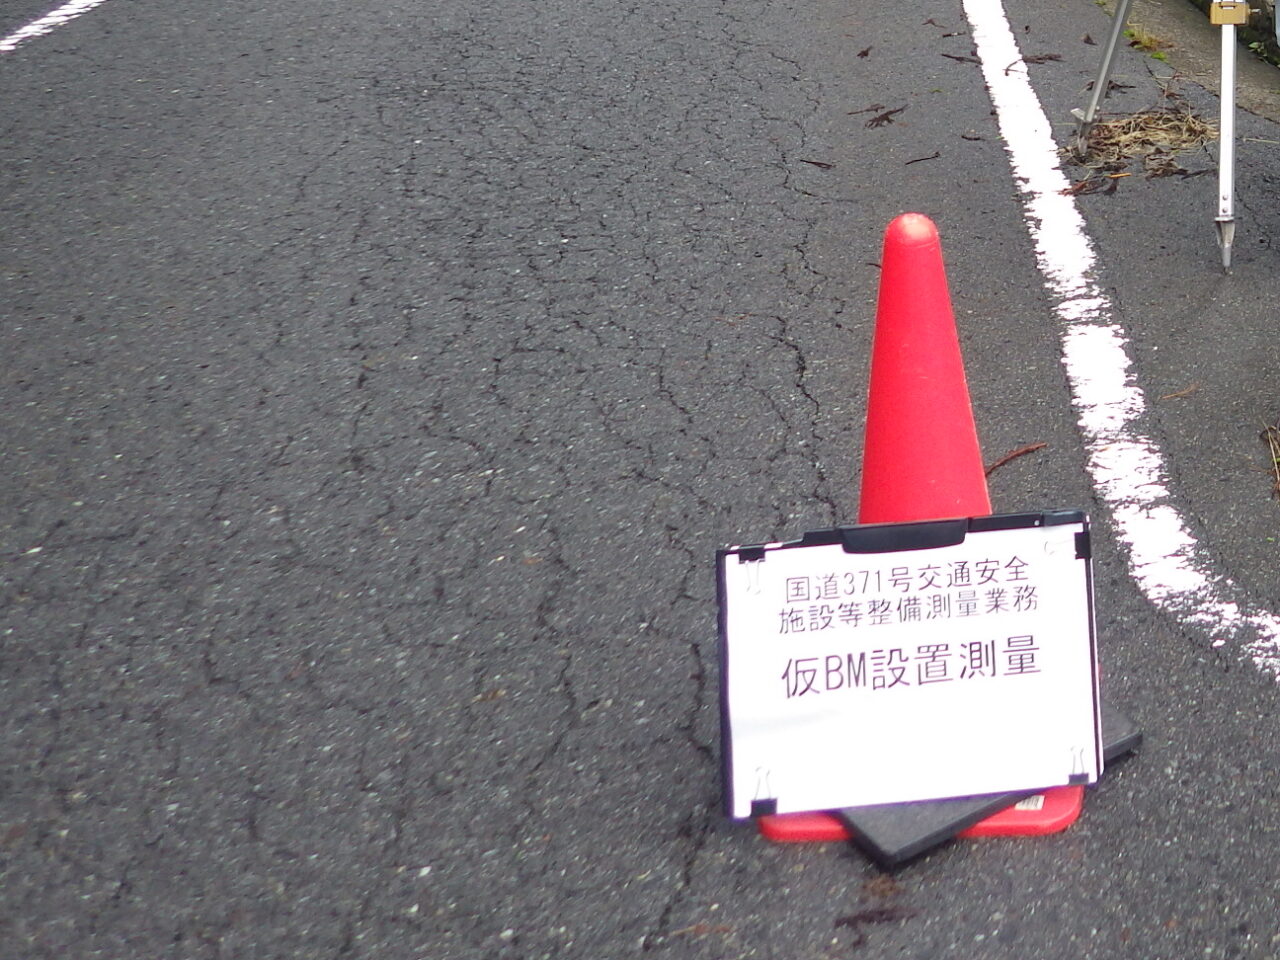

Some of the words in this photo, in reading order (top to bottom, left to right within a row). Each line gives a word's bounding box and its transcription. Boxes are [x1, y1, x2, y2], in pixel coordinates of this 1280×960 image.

[786, 555, 1030, 603] 国道371号交通安全
[779, 585, 1039, 634] 施設等整備測量業務
[782, 635, 1041, 698] 仮BM設置測量
